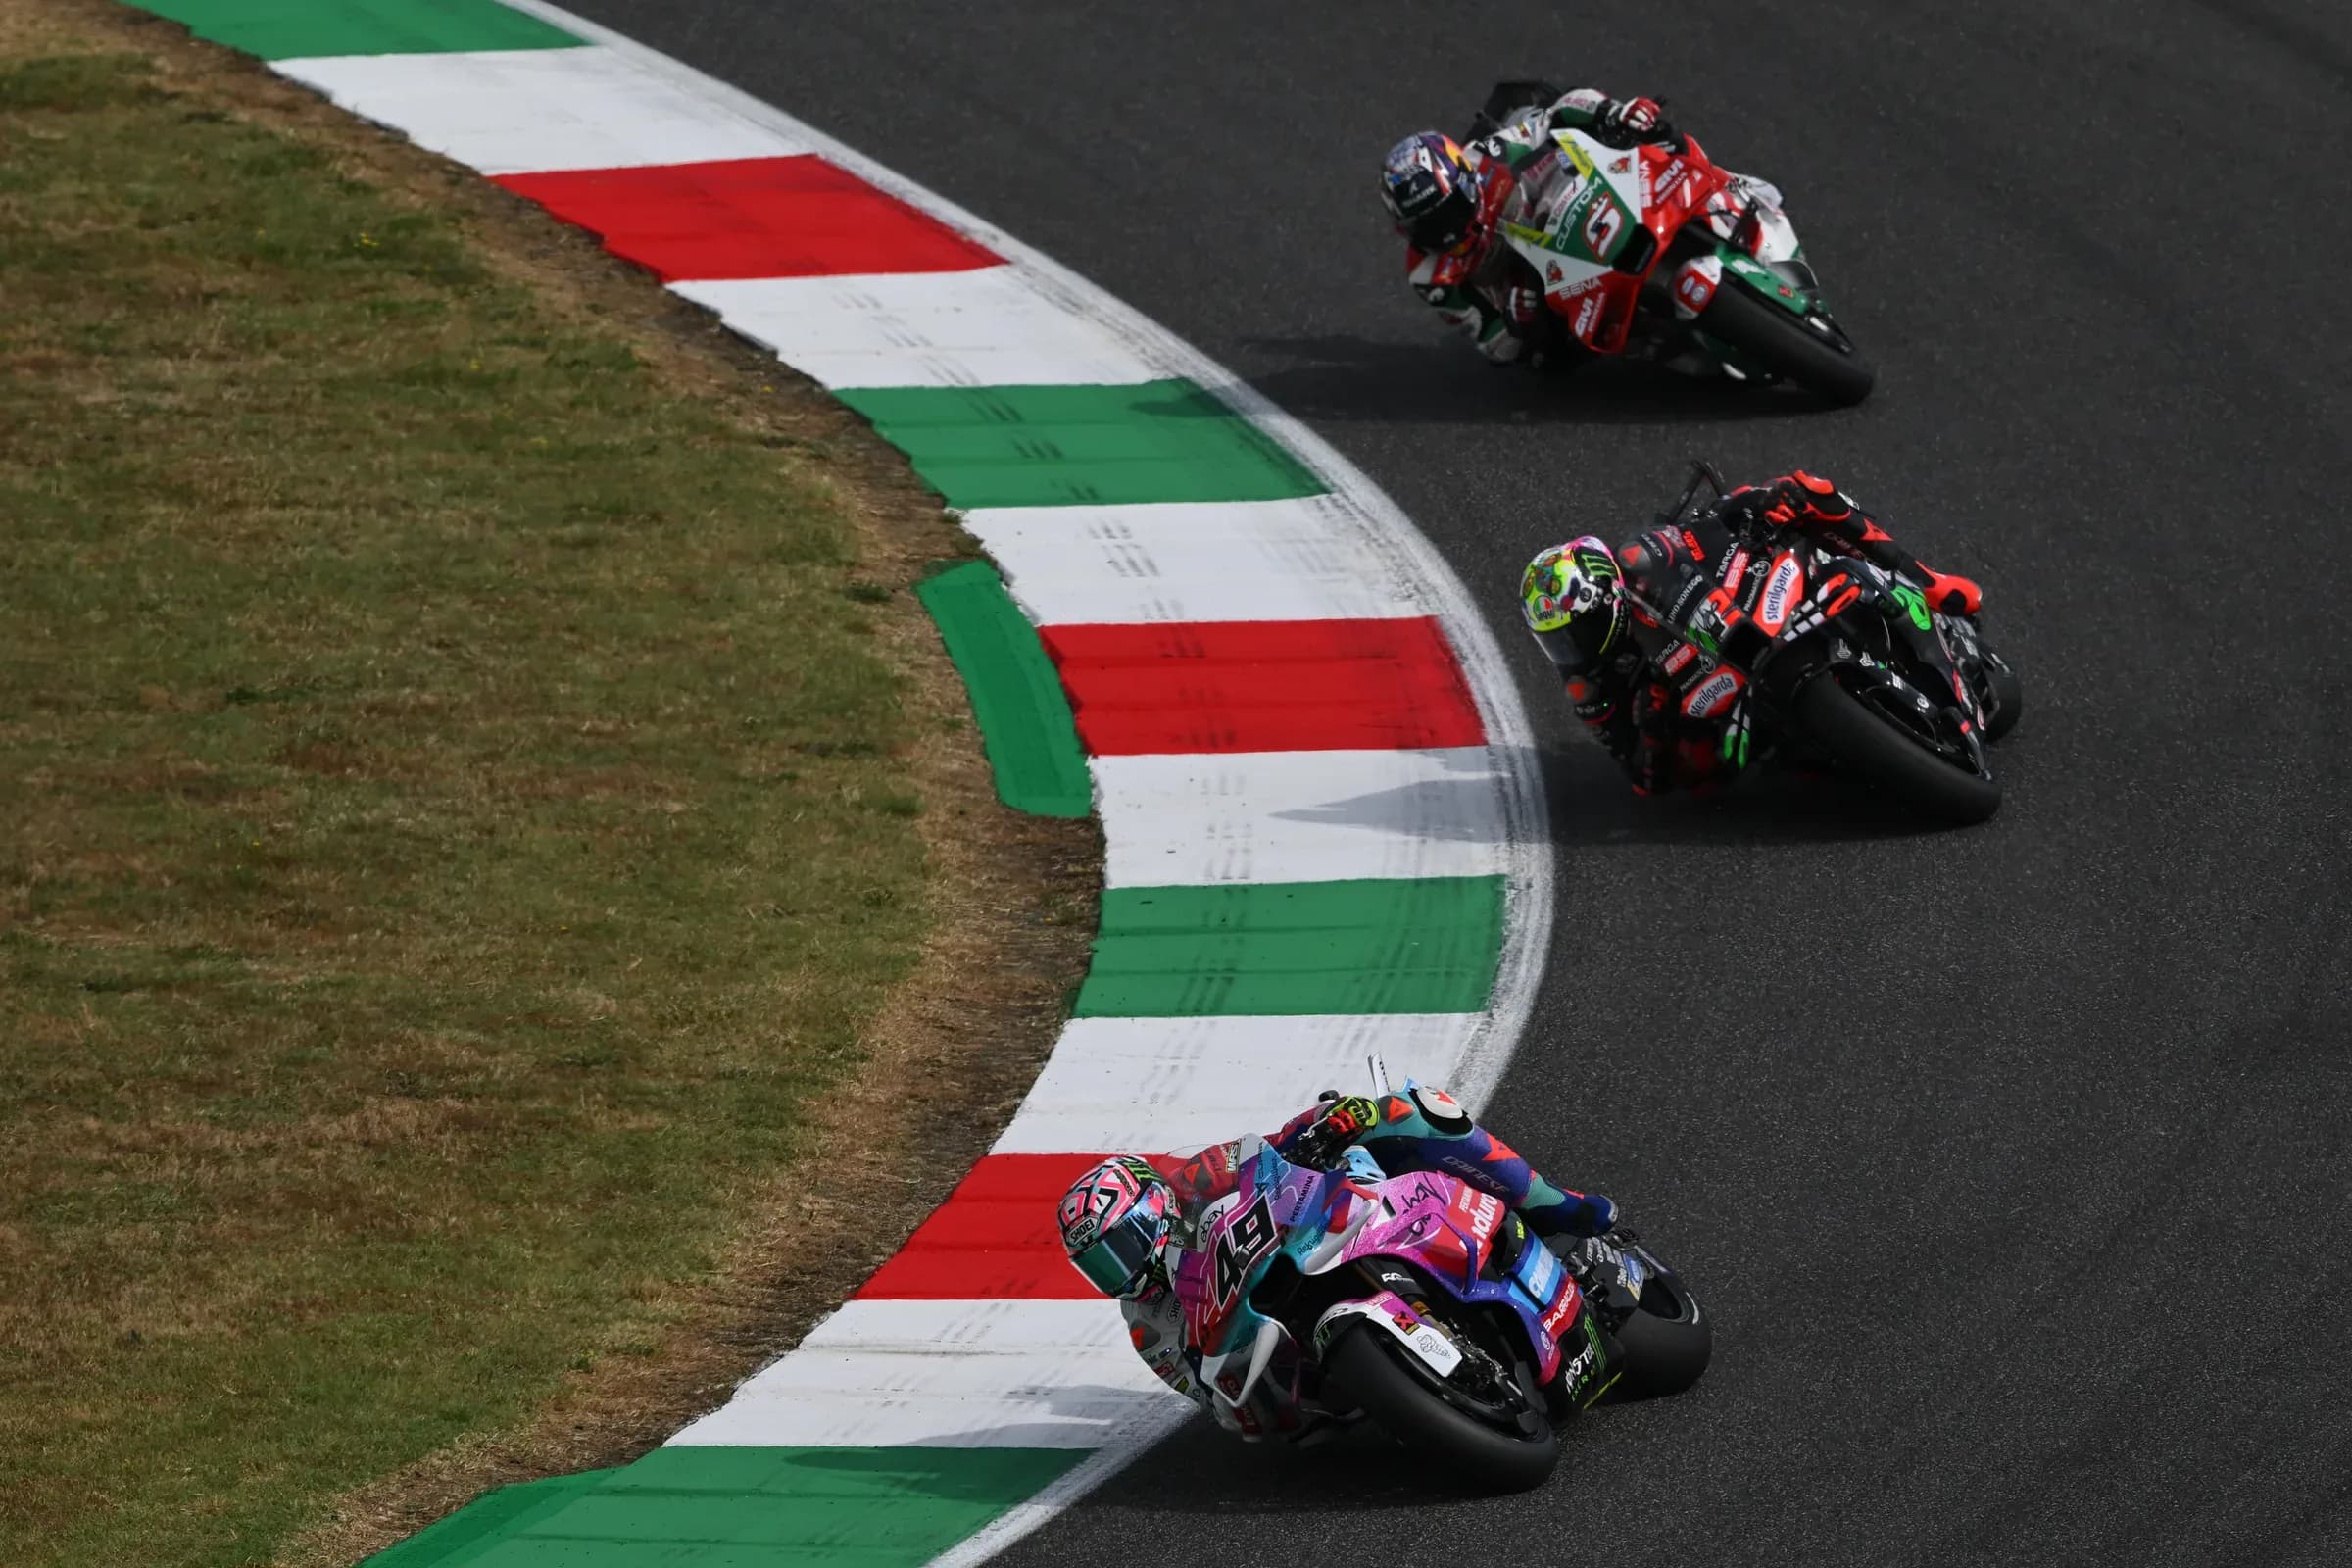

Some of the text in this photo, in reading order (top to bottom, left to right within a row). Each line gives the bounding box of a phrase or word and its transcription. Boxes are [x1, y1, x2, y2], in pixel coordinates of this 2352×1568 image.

[1639, 160, 1653, 208] SENA
[1654, 159, 1685, 193] GIVI
[1556, 177, 1603, 251] CUSTOM
[1584, 193, 1623, 262] 5
[1558, 276, 1603, 301] SENA
[1575, 296, 1594, 338] GIVI
[1716, 542, 1740, 578] TARGA
[1690, 674, 1734, 716] sterilgarda
[1290, 1175, 1315, 1223] PERTAMINA
[1070, 1218, 1096, 1243] SHOEI
[1215, 1193, 1278, 1314] 49
